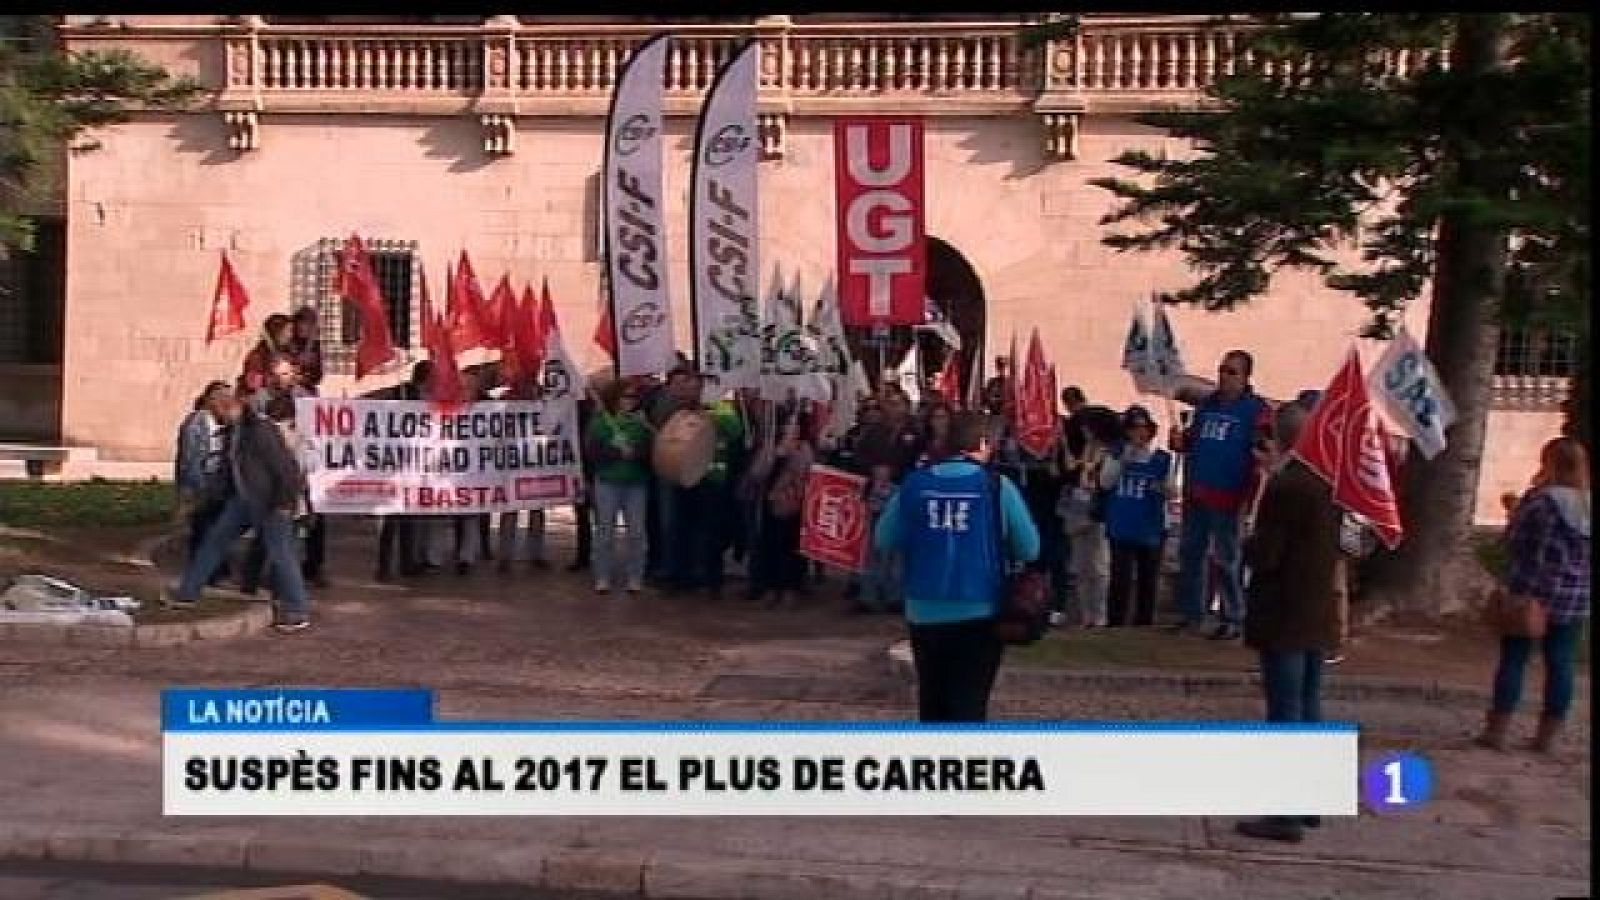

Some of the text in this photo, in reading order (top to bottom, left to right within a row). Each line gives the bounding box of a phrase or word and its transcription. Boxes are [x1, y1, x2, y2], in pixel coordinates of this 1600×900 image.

[847, 124, 913, 316] UGT
[315, 405, 355, 436] NO
[364, 411, 379, 438] A
[387, 411, 431, 438] LOS
[325, 443, 356, 471] LA
